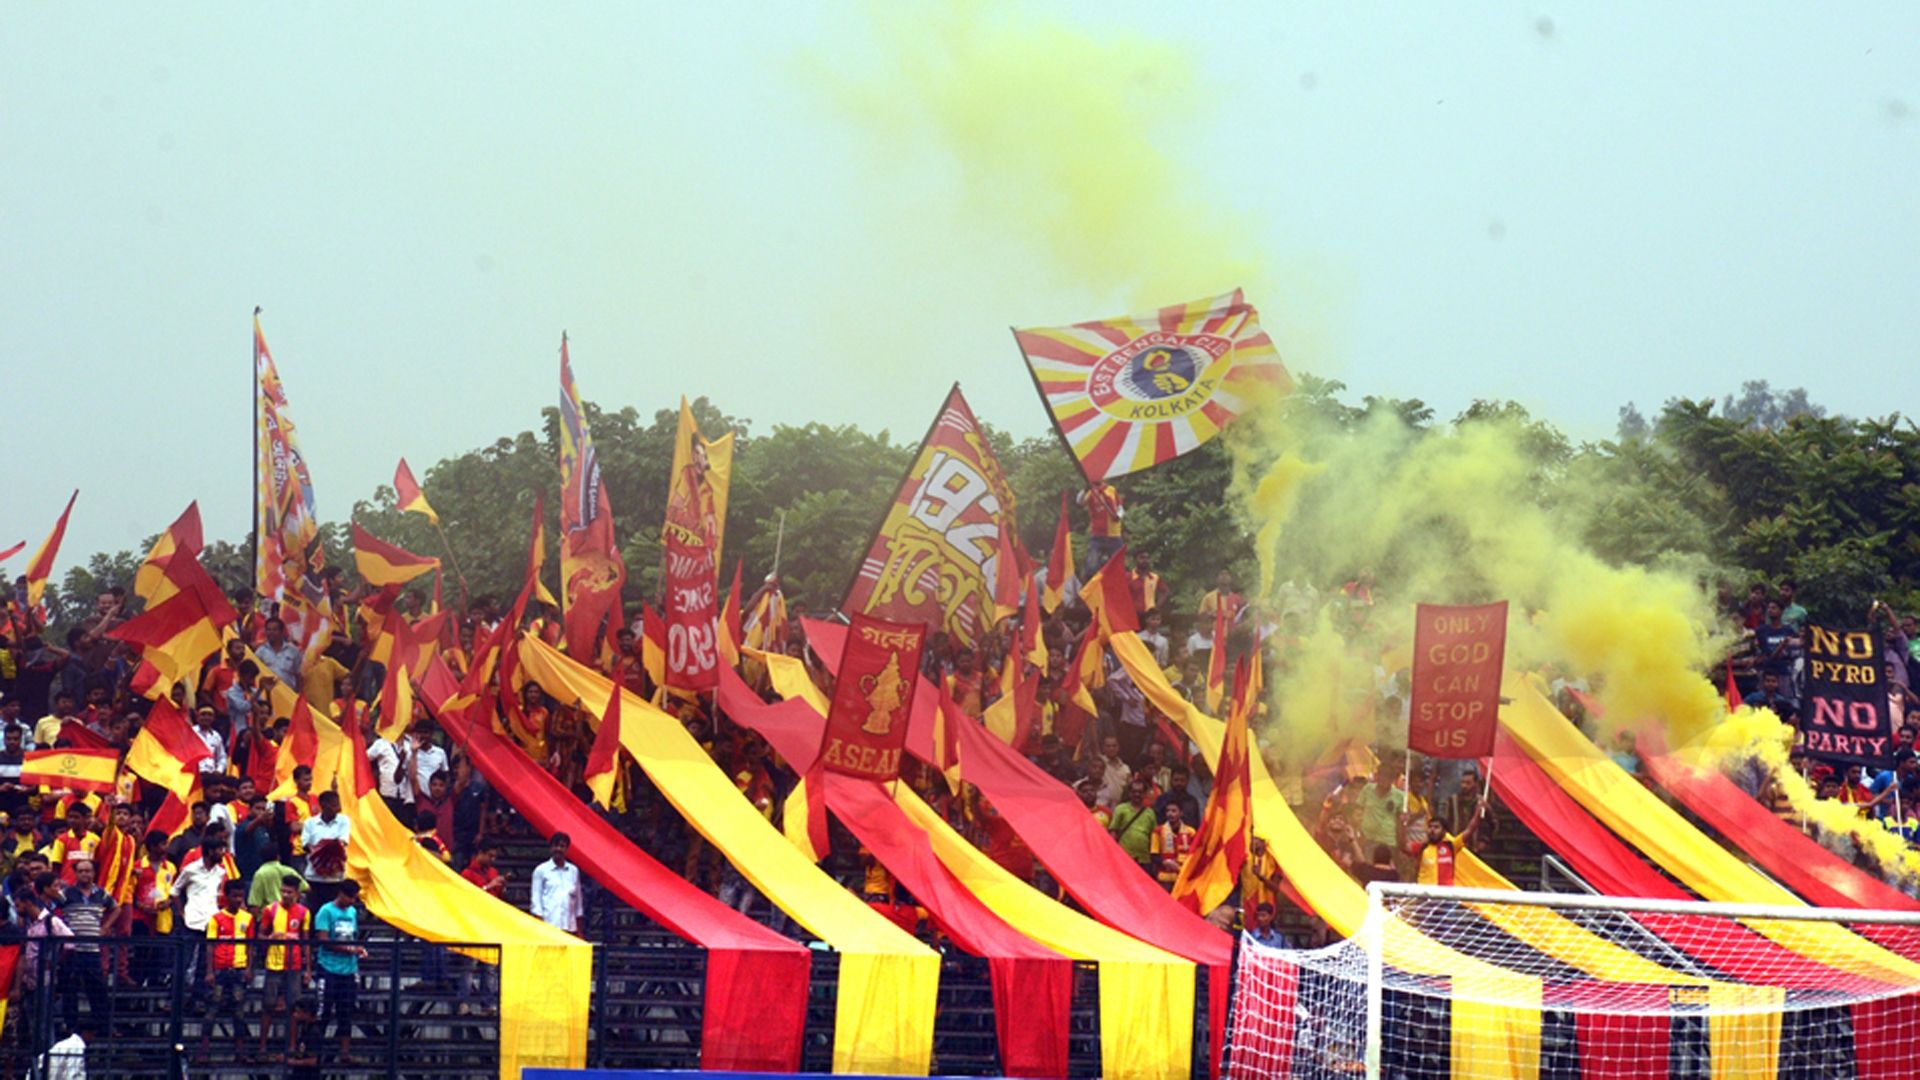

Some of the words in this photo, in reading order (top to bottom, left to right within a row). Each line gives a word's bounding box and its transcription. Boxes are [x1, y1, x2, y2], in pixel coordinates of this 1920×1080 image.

[1130, 379, 1214, 418] KOLKATA
[909, 451, 998, 600] 192
[1434, 615, 1489, 634] ONLY
[1430, 642, 1489, 666] GOD
[1809, 625, 1873, 659] NO
[1811, 660, 1875, 683] PYRO
[1433, 675, 1480, 693] CAN
[1420, 701, 1483, 721] STOP
[1812, 697, 1877, 730] NO
[1435, 730, 1467, 747] US
[1807, 731, 1887, 757] PARTY
